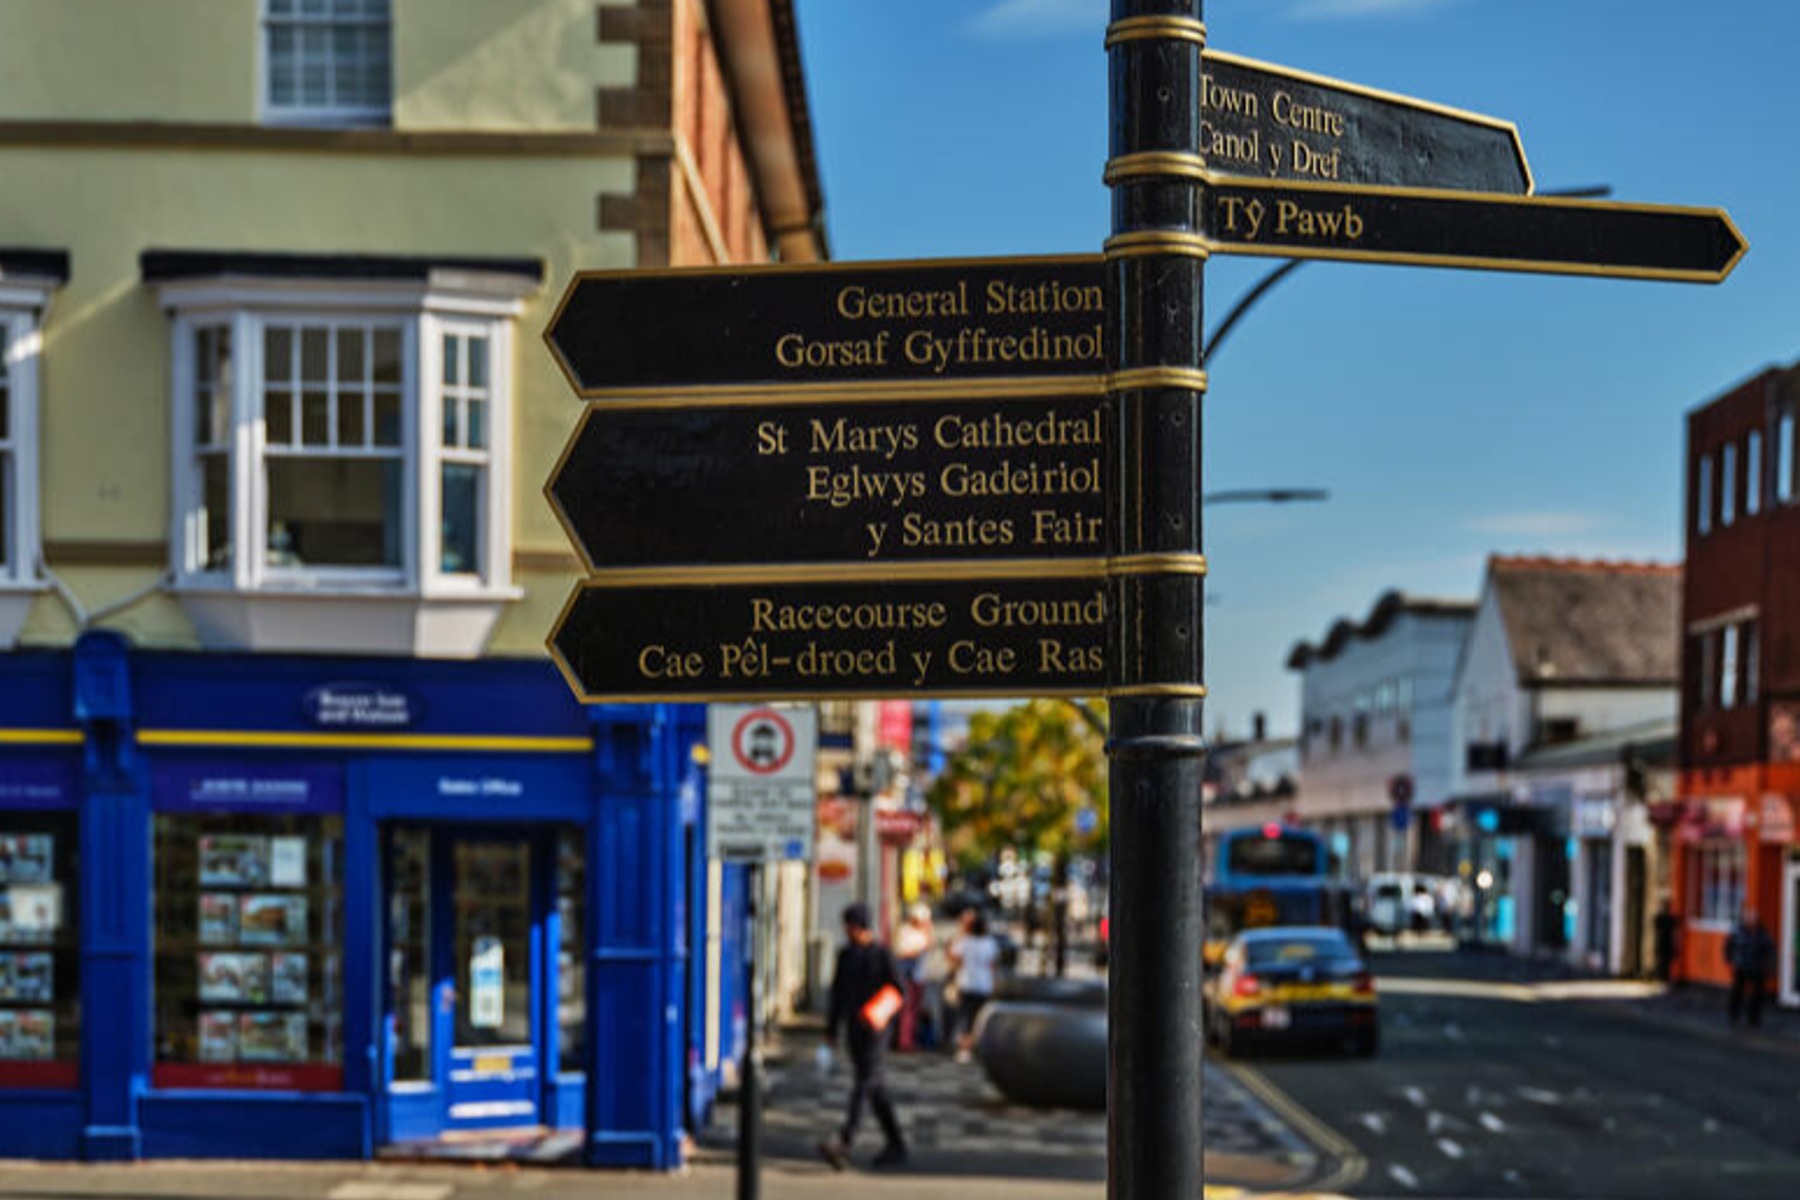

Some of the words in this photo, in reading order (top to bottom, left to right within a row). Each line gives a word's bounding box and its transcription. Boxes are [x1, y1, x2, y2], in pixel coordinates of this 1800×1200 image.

[1200, 74, 1258, 118] Town
[1273, 91, 1343, 137] Centre
[1269, 143, 1281, 177] y
[1293, 140, 1341, 179] Dref
[1218, 197, 1264, 238] Tŷ
[1276, 200, 1363, 239] Pawb
[837, 280, 969, 320] General
[986, 280, 1103, 314] Station
[775, 331, 890, 367] Gorsaf
[904, 325, 1102, 372] Gyffredinol
[758, 422, 786, 454] St
[810, 418, 918, 459] Marys
[934, 409, 1101, 449] Cathedral
[807, 464, 925, 507] Eglwys
[941, 458, 1100, 497] Gadeiriol
[867, 523, 886, 556] y
[903, 512, 1014, 547] Santes
[1032, 510, 1102, 544] Fair
[752, 598, 946, 632] Racecourse
[971, 591, 1104, 627] Ground
[638, 645, 703, 678] Cae
[720, 636, 896, 678] Pêl-droed
[911, 651, 932, 686] y
[947, 640, 1015, 675] Cae
[1039, 639, 1104, 673] Ras
